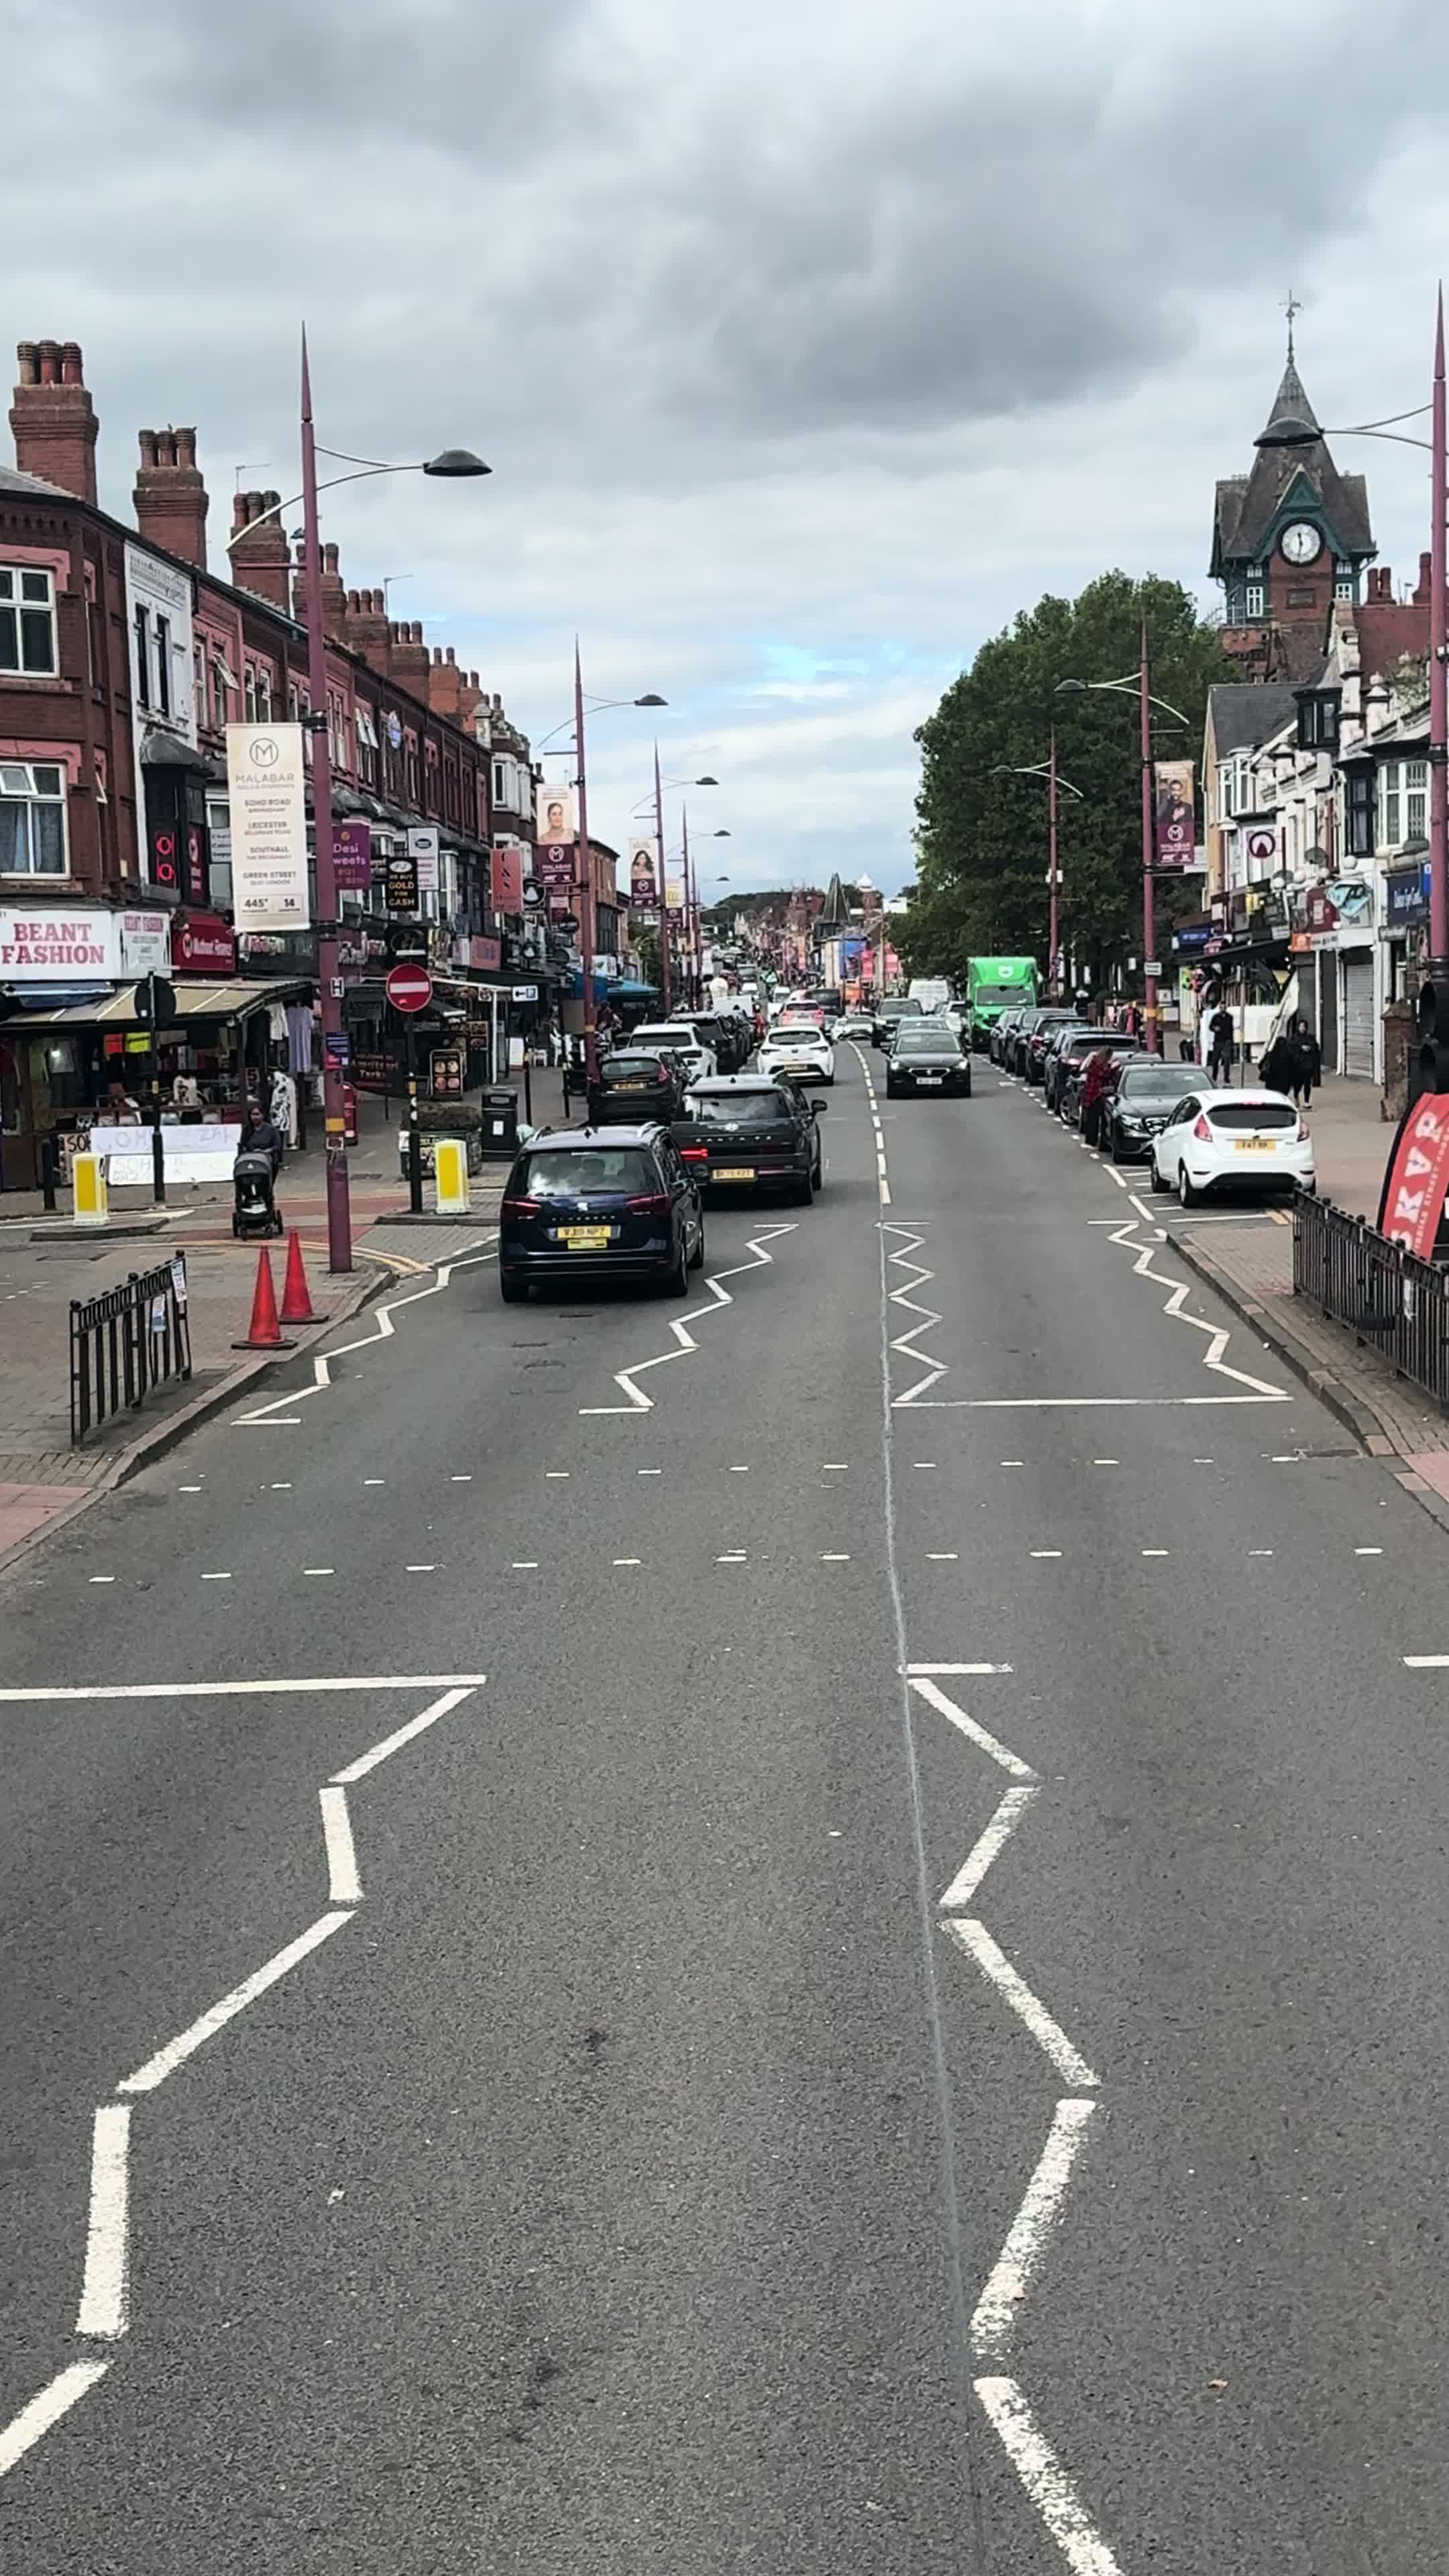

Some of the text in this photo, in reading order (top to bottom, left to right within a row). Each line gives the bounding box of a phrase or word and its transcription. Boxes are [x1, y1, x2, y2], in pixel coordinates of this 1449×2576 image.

[236, 773, 294, 782] MALABAR
[333, 843, 358, 853] Desi
[333, 856, 366, 865] weets
[388, 881, 414, 889] GOLD
[284, 899, 295, 908] 14
[13, 922, 92, 941] BEANT
[1, 945, 105, 964] FASHION
